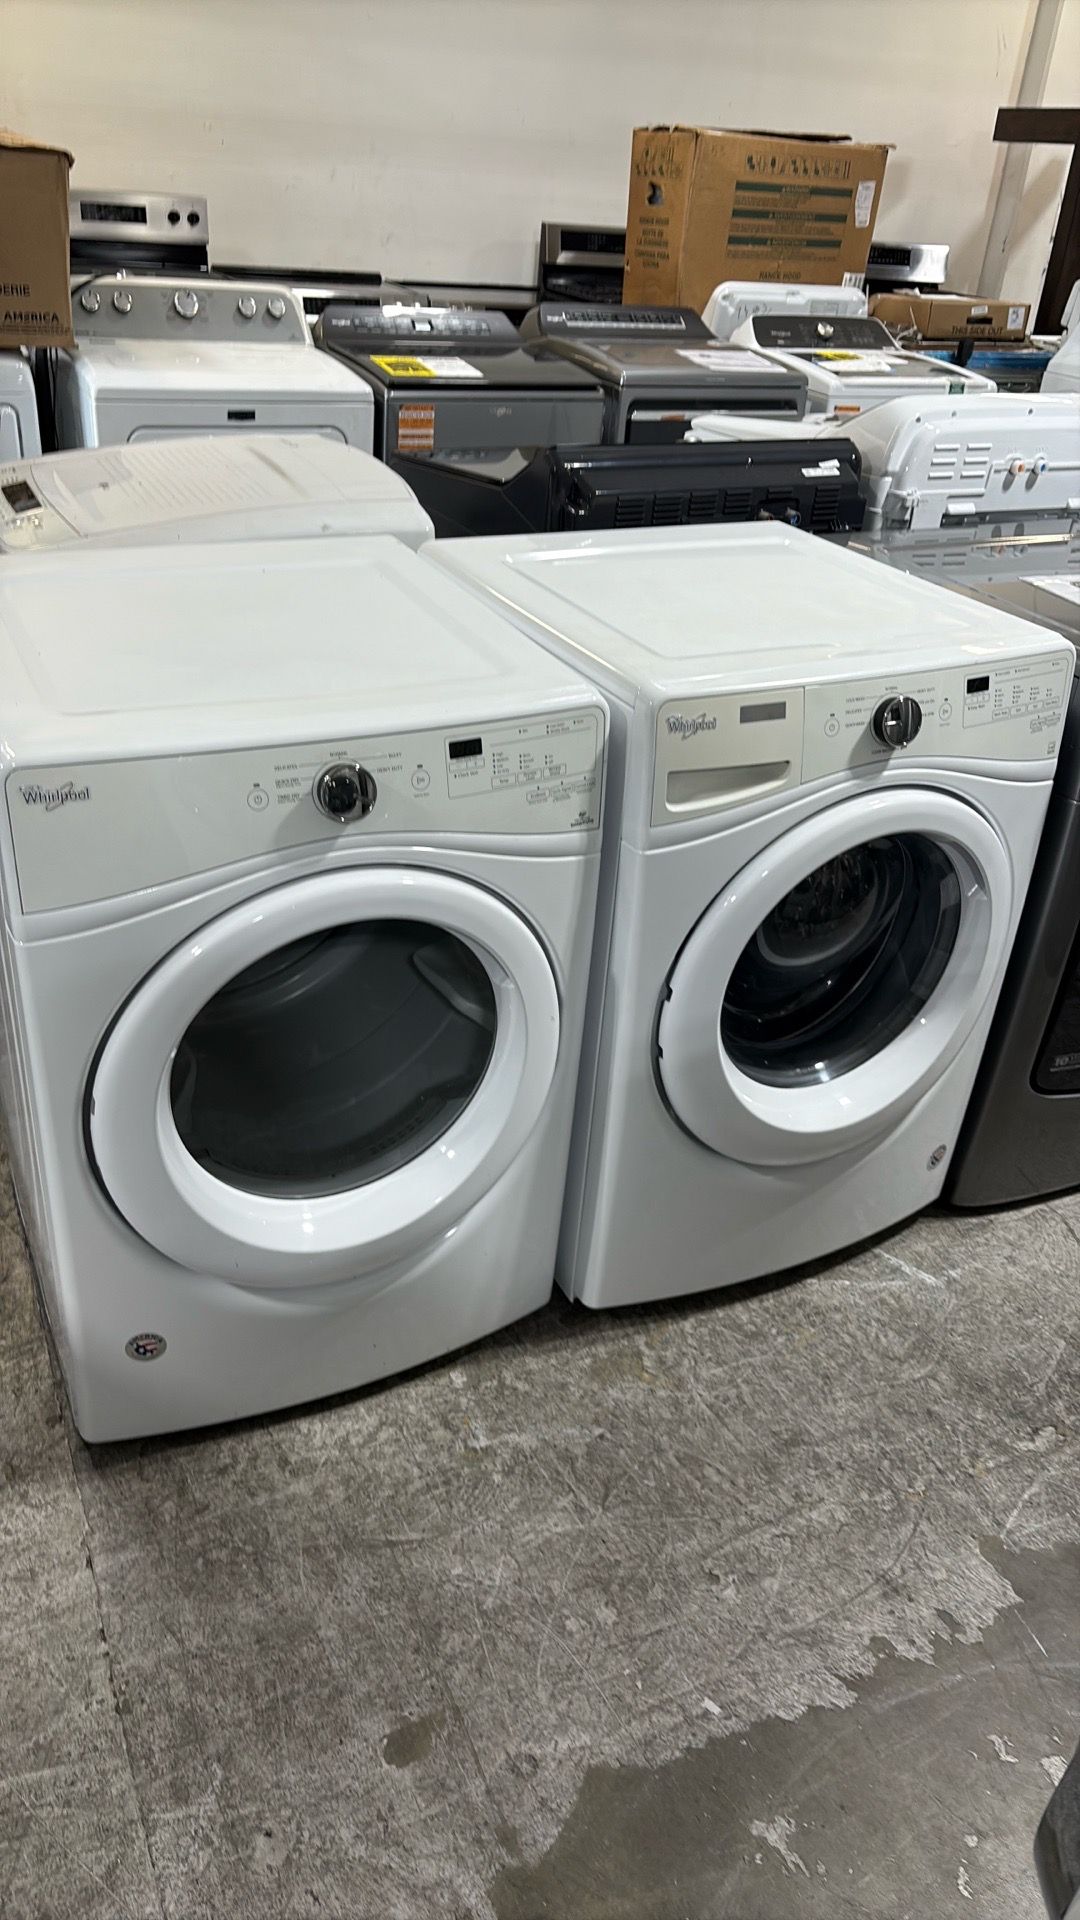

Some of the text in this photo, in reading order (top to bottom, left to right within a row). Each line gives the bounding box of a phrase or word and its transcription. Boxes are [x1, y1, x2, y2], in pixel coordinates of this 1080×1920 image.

[0, 283, 31, 297] ERIE
[4, 311, 60, 323] AMERICA
[952, 325, 968, 334] THIS
[988, 326, 1004, 336] OUT
[665, 714, 717, 738] Whirlpool
[19, 783, 90, 809] Whirlpool
